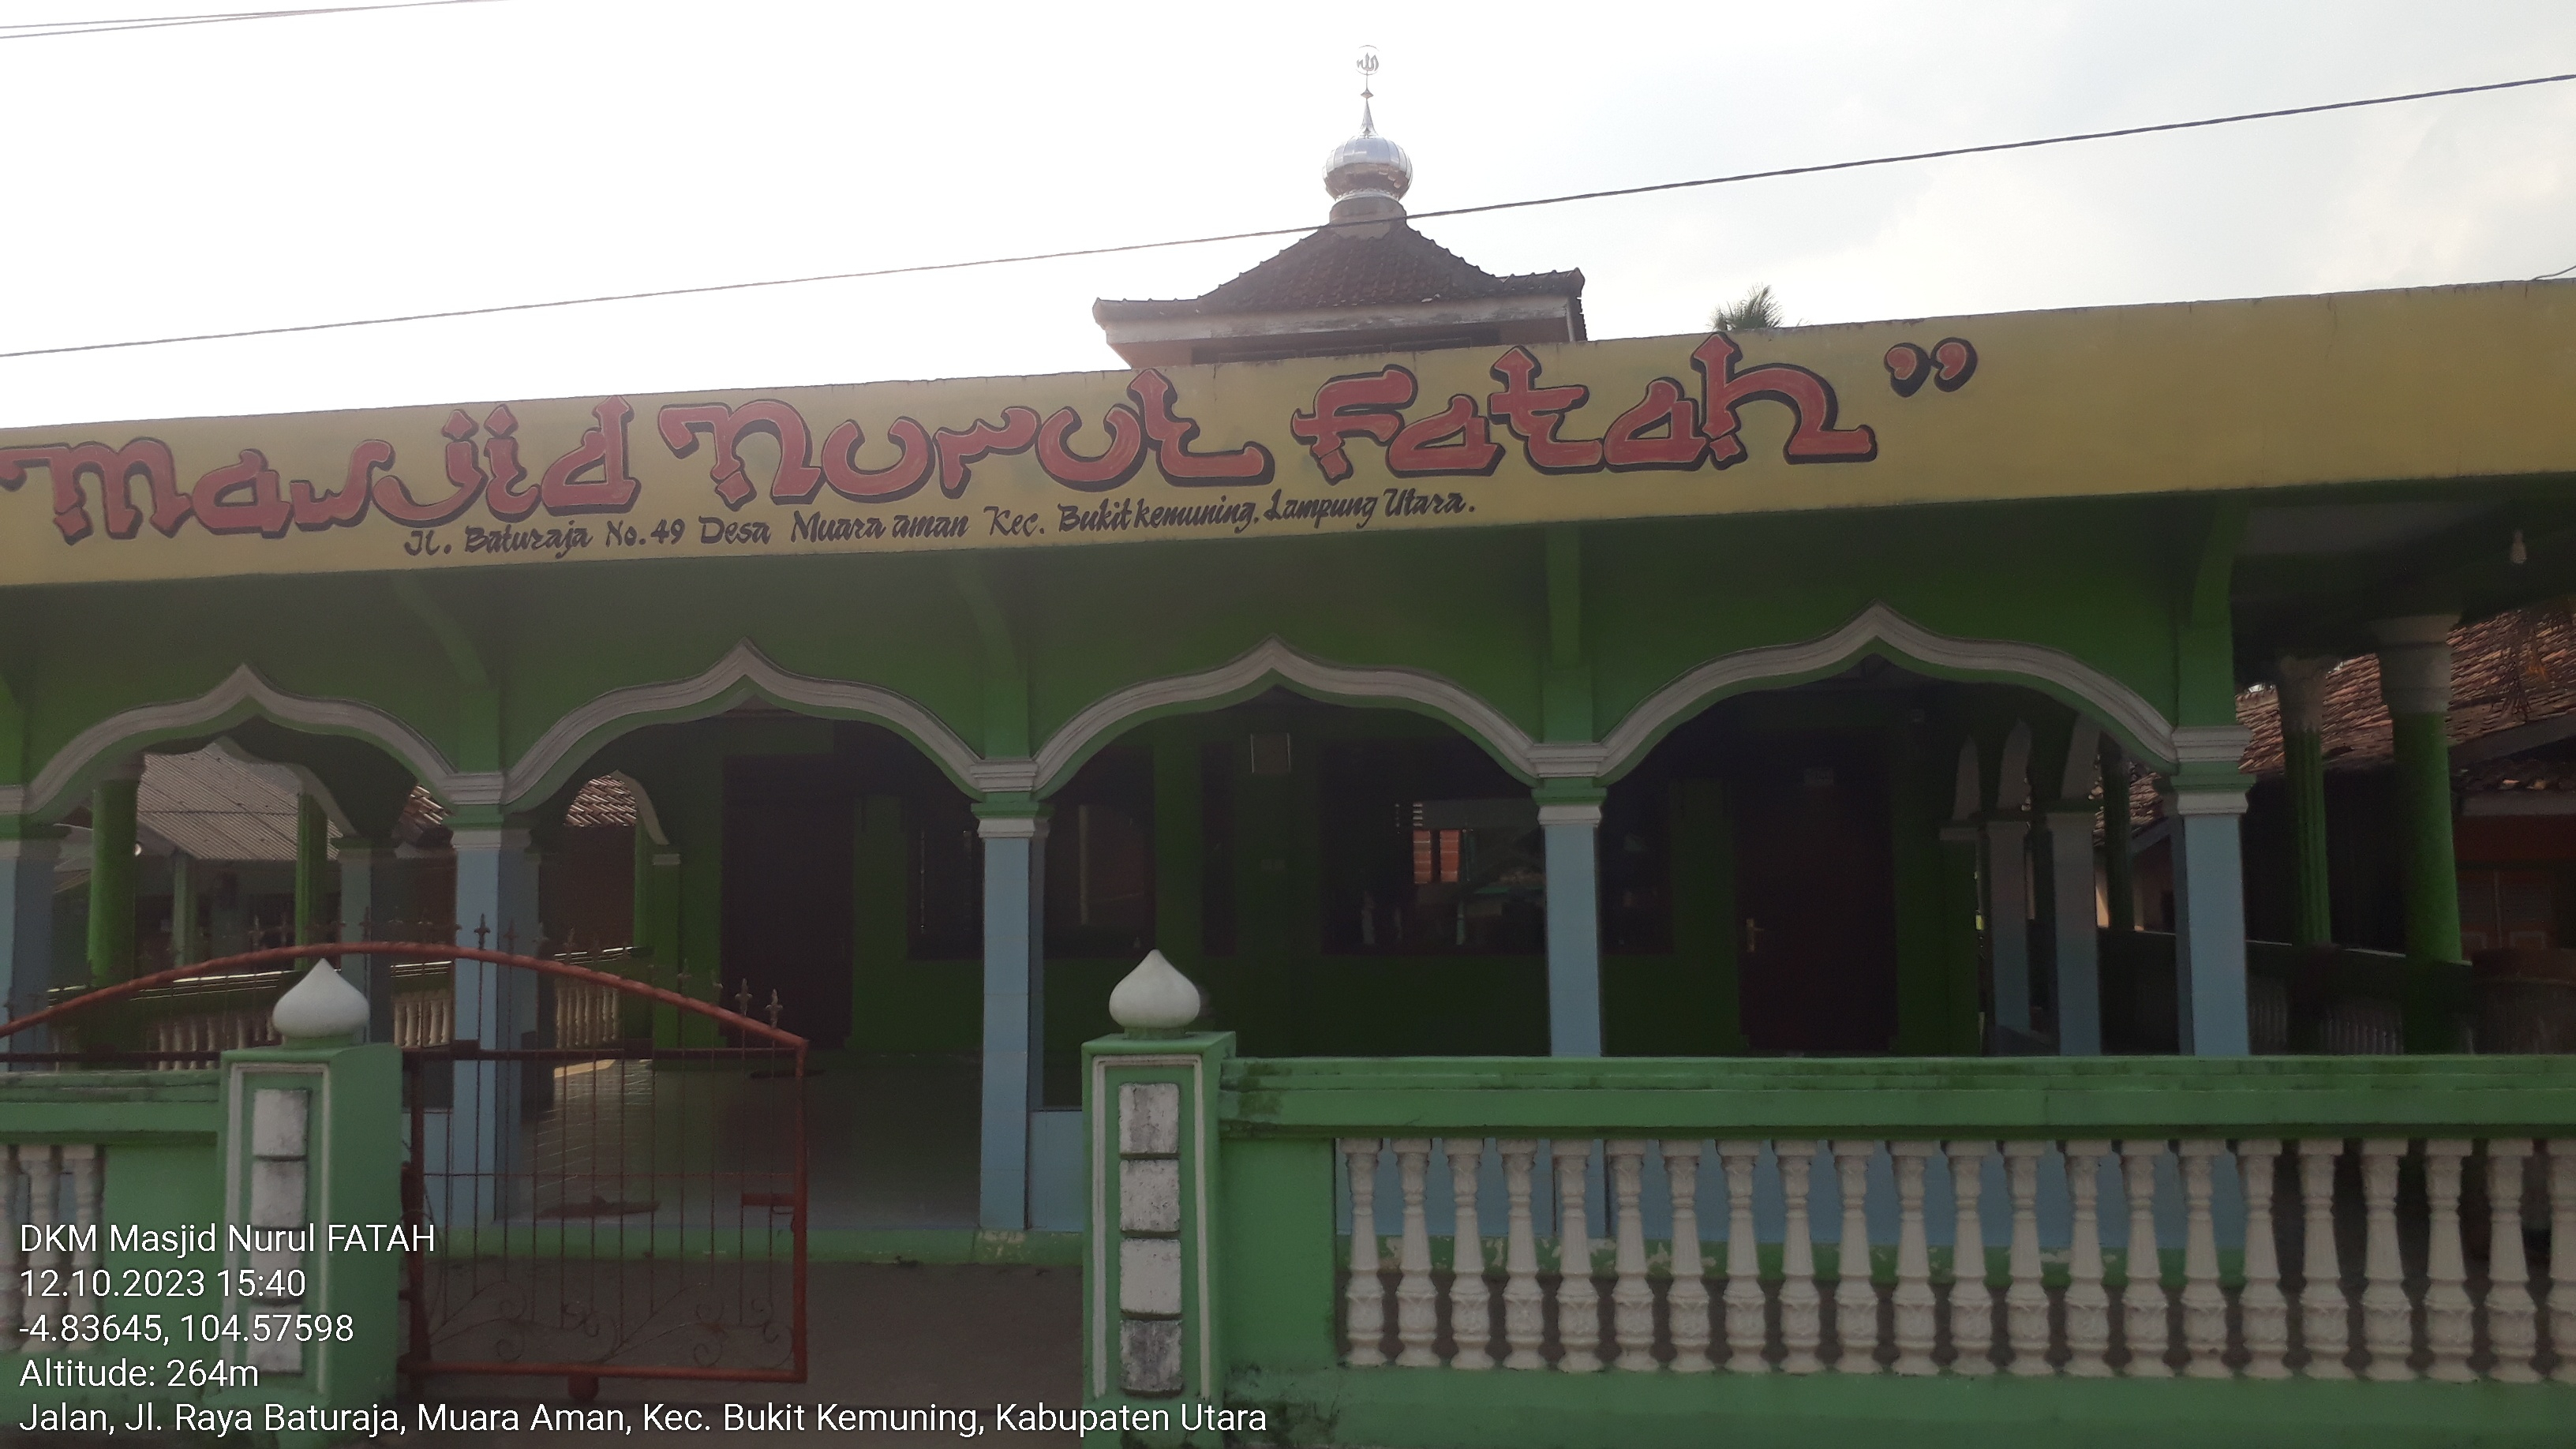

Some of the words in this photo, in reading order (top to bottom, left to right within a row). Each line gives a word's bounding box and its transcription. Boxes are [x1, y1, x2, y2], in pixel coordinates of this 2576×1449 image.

[404, 530, 452, 556] Jl.
[465, 521, 593, 559] Baturaja
[605, 519, 647, 547] No.
[650, 518, 687, 545] 49
[698, 515, 771, 545] Desa
[983, 506, 1045, 537] Kec.
[1264, 488, 1379, 530] Lampung
[1383, 488, 1476, 518] Utara.
